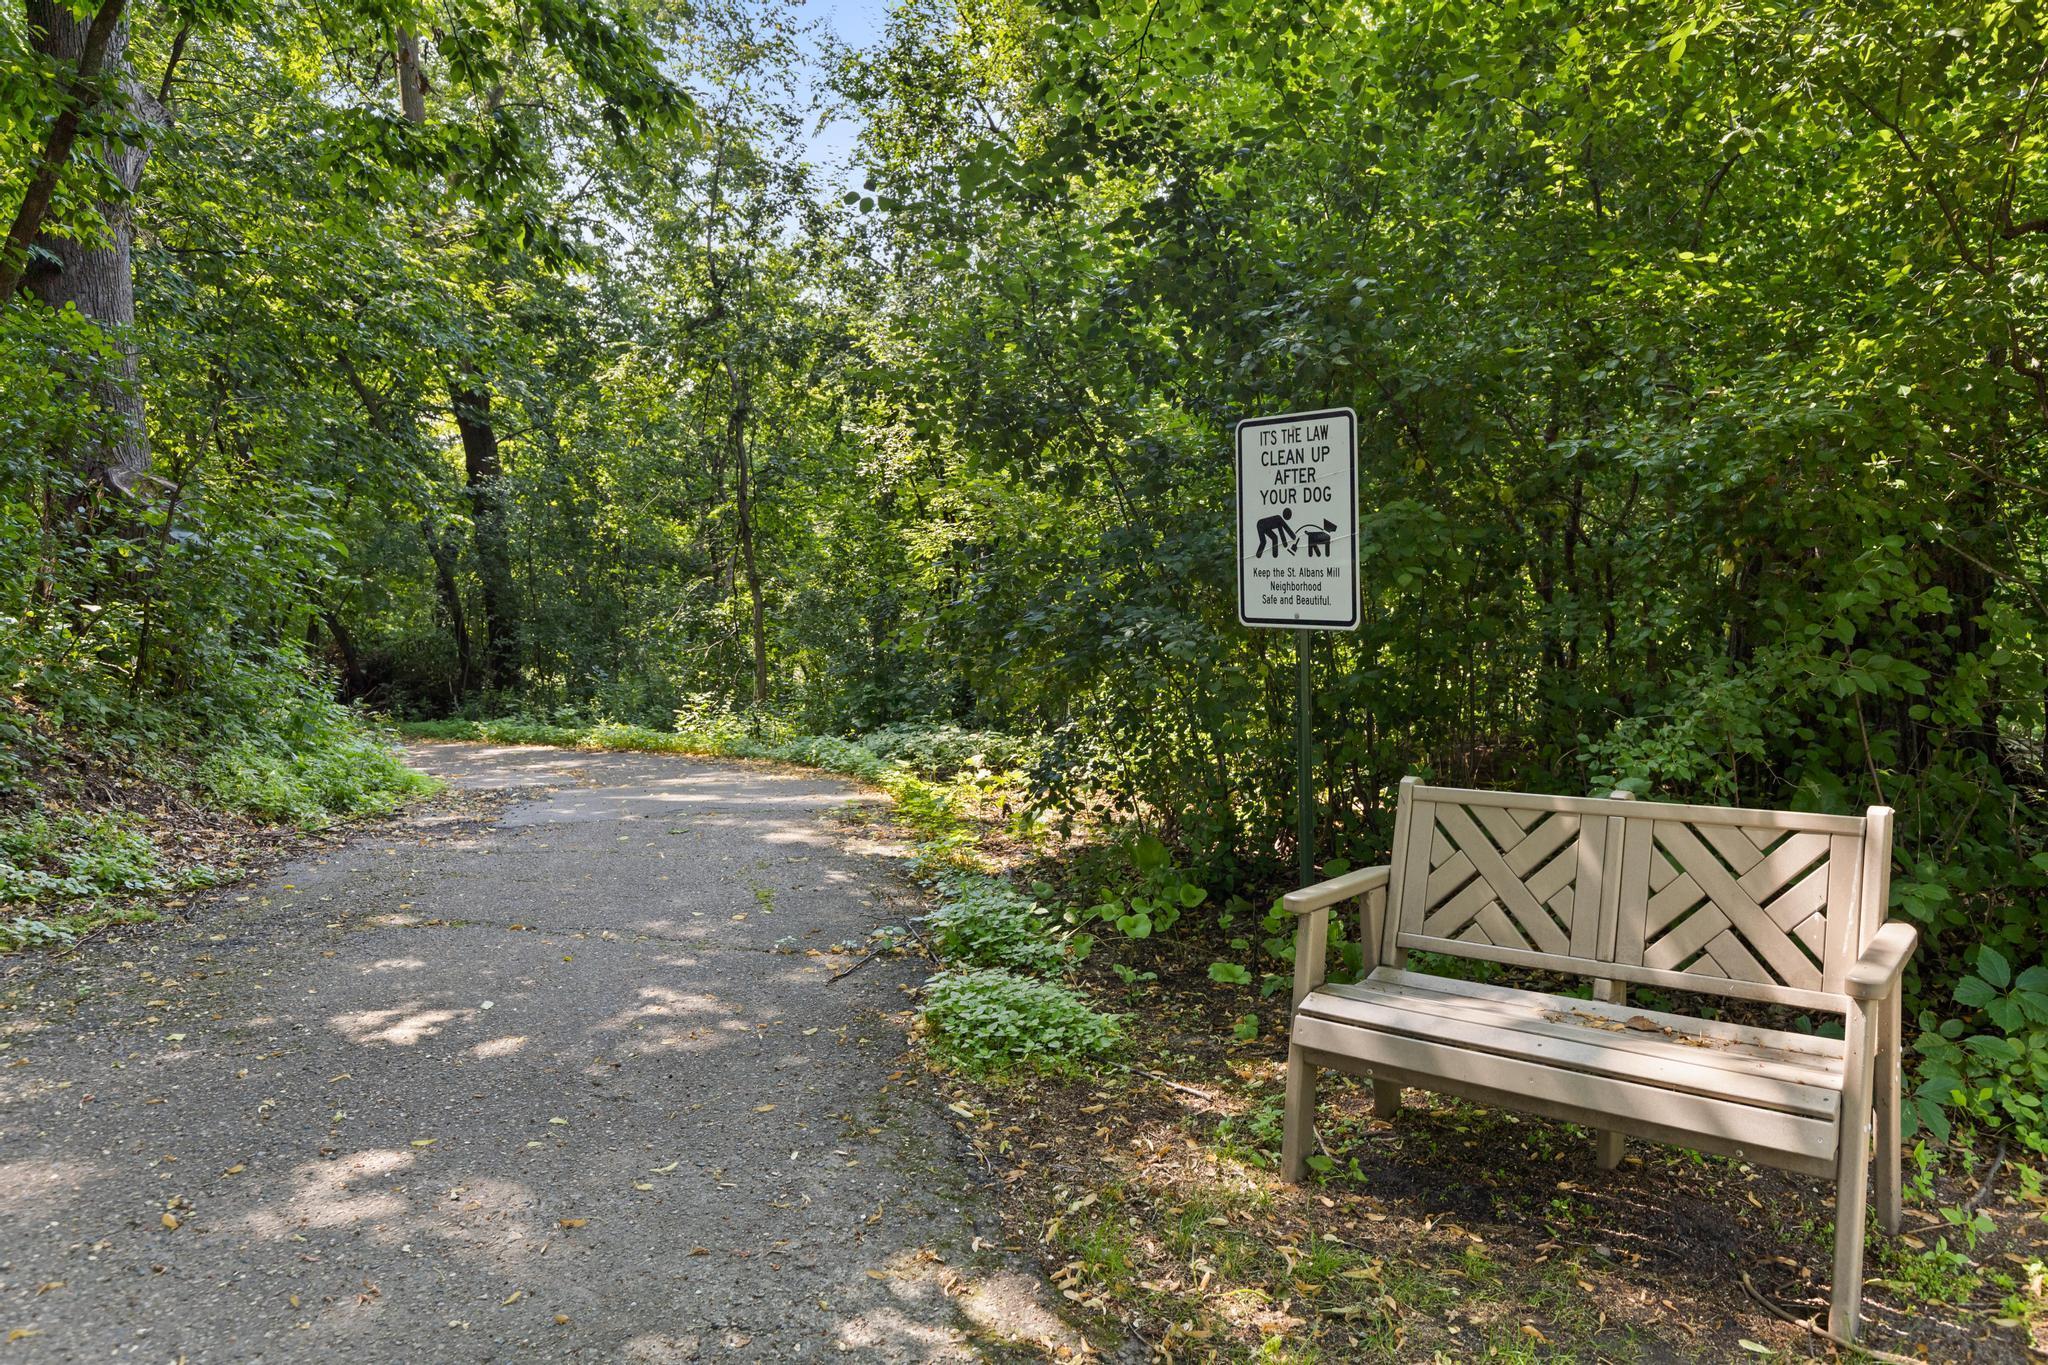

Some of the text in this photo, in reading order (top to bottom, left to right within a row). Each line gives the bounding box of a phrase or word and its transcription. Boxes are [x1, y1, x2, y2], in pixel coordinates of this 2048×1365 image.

[1281, 427, 1301, 444] THE
[1307, 424, 1329, 442] LAW
[1261, 446, 1330, 467] CLEAN UP
[1274, 467, 1316, 485] AFTER
[1260, 486, 1332, 505] YOUR DOG
[1253, 567, 1340, 579] Keep the St. Albans Mill
[1270, 581, 1322, 594] Neighborhood
[1262, 594, 1332, 606] Safe and Beautiful.
